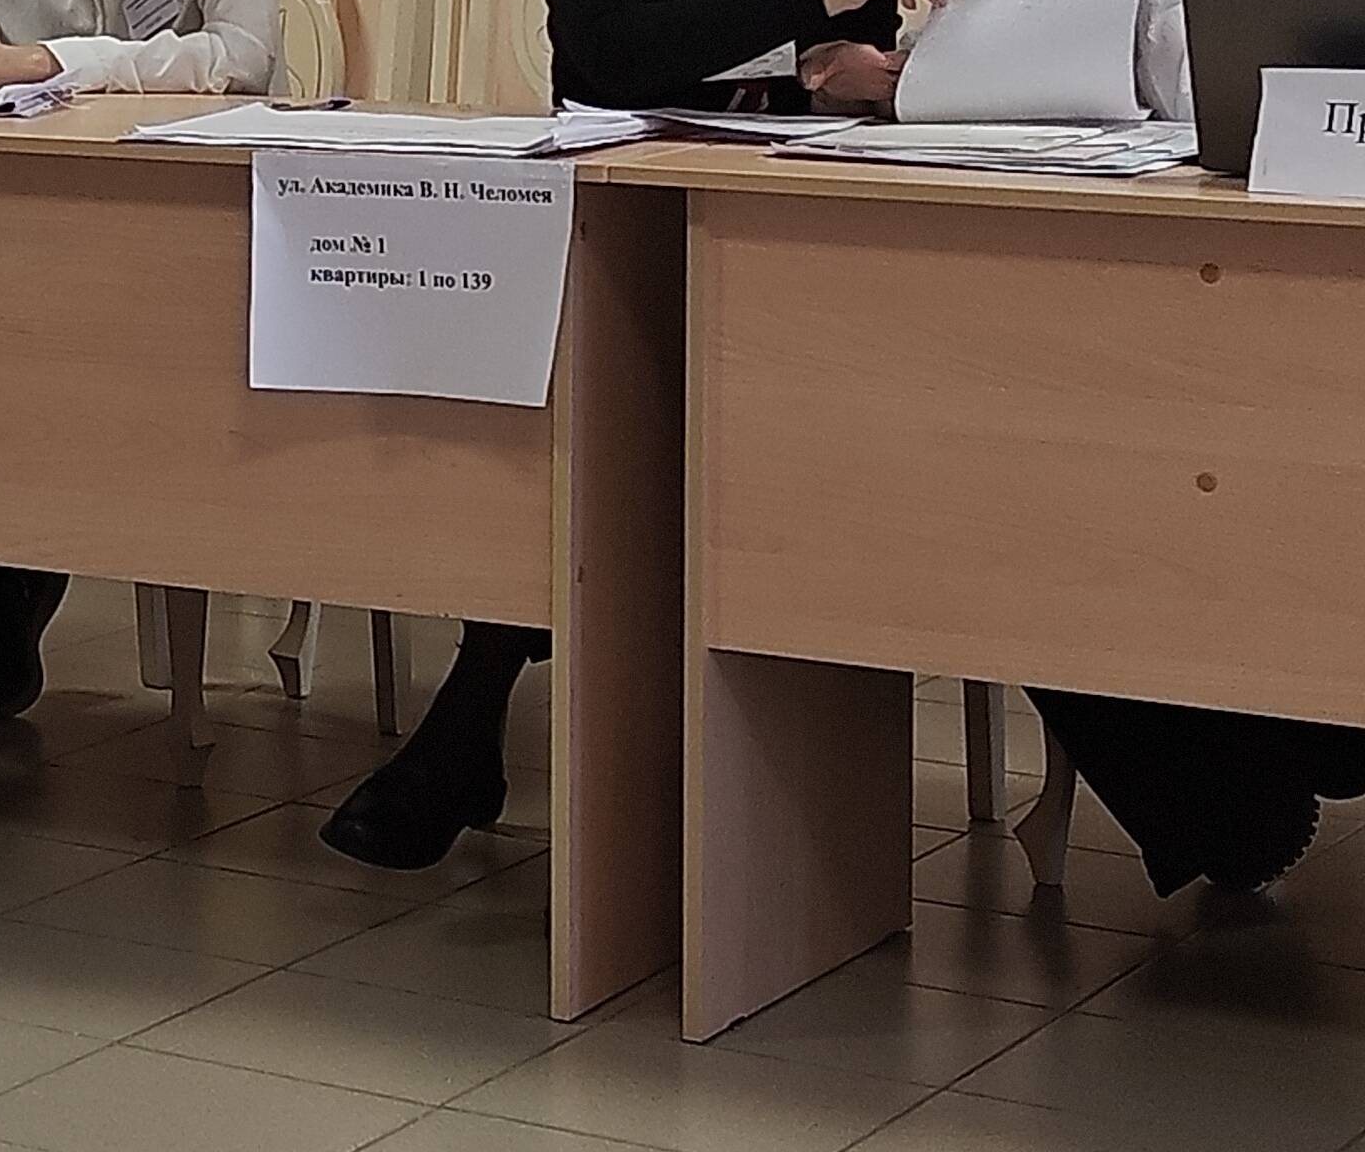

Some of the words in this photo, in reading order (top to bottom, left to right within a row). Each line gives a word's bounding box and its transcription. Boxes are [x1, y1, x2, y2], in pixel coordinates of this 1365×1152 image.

[278, 179, 306, 197] ул.
[310, 177, 414, 197] Академика
[419, 180, 438, 198] В.
[444, 182, 465, 200] Н.
[470, 182, 552, 204] Челомея
[310, 238, 345, 252] дом
[349, 235, 371, 254] №
[378, 237, 385, 254] 1
[310, 269, 411, 289] квартиры:
[419, 270, 426, 287] 1
[433, 275, 456, 289] по
[462, 272, 492, 290] 139
